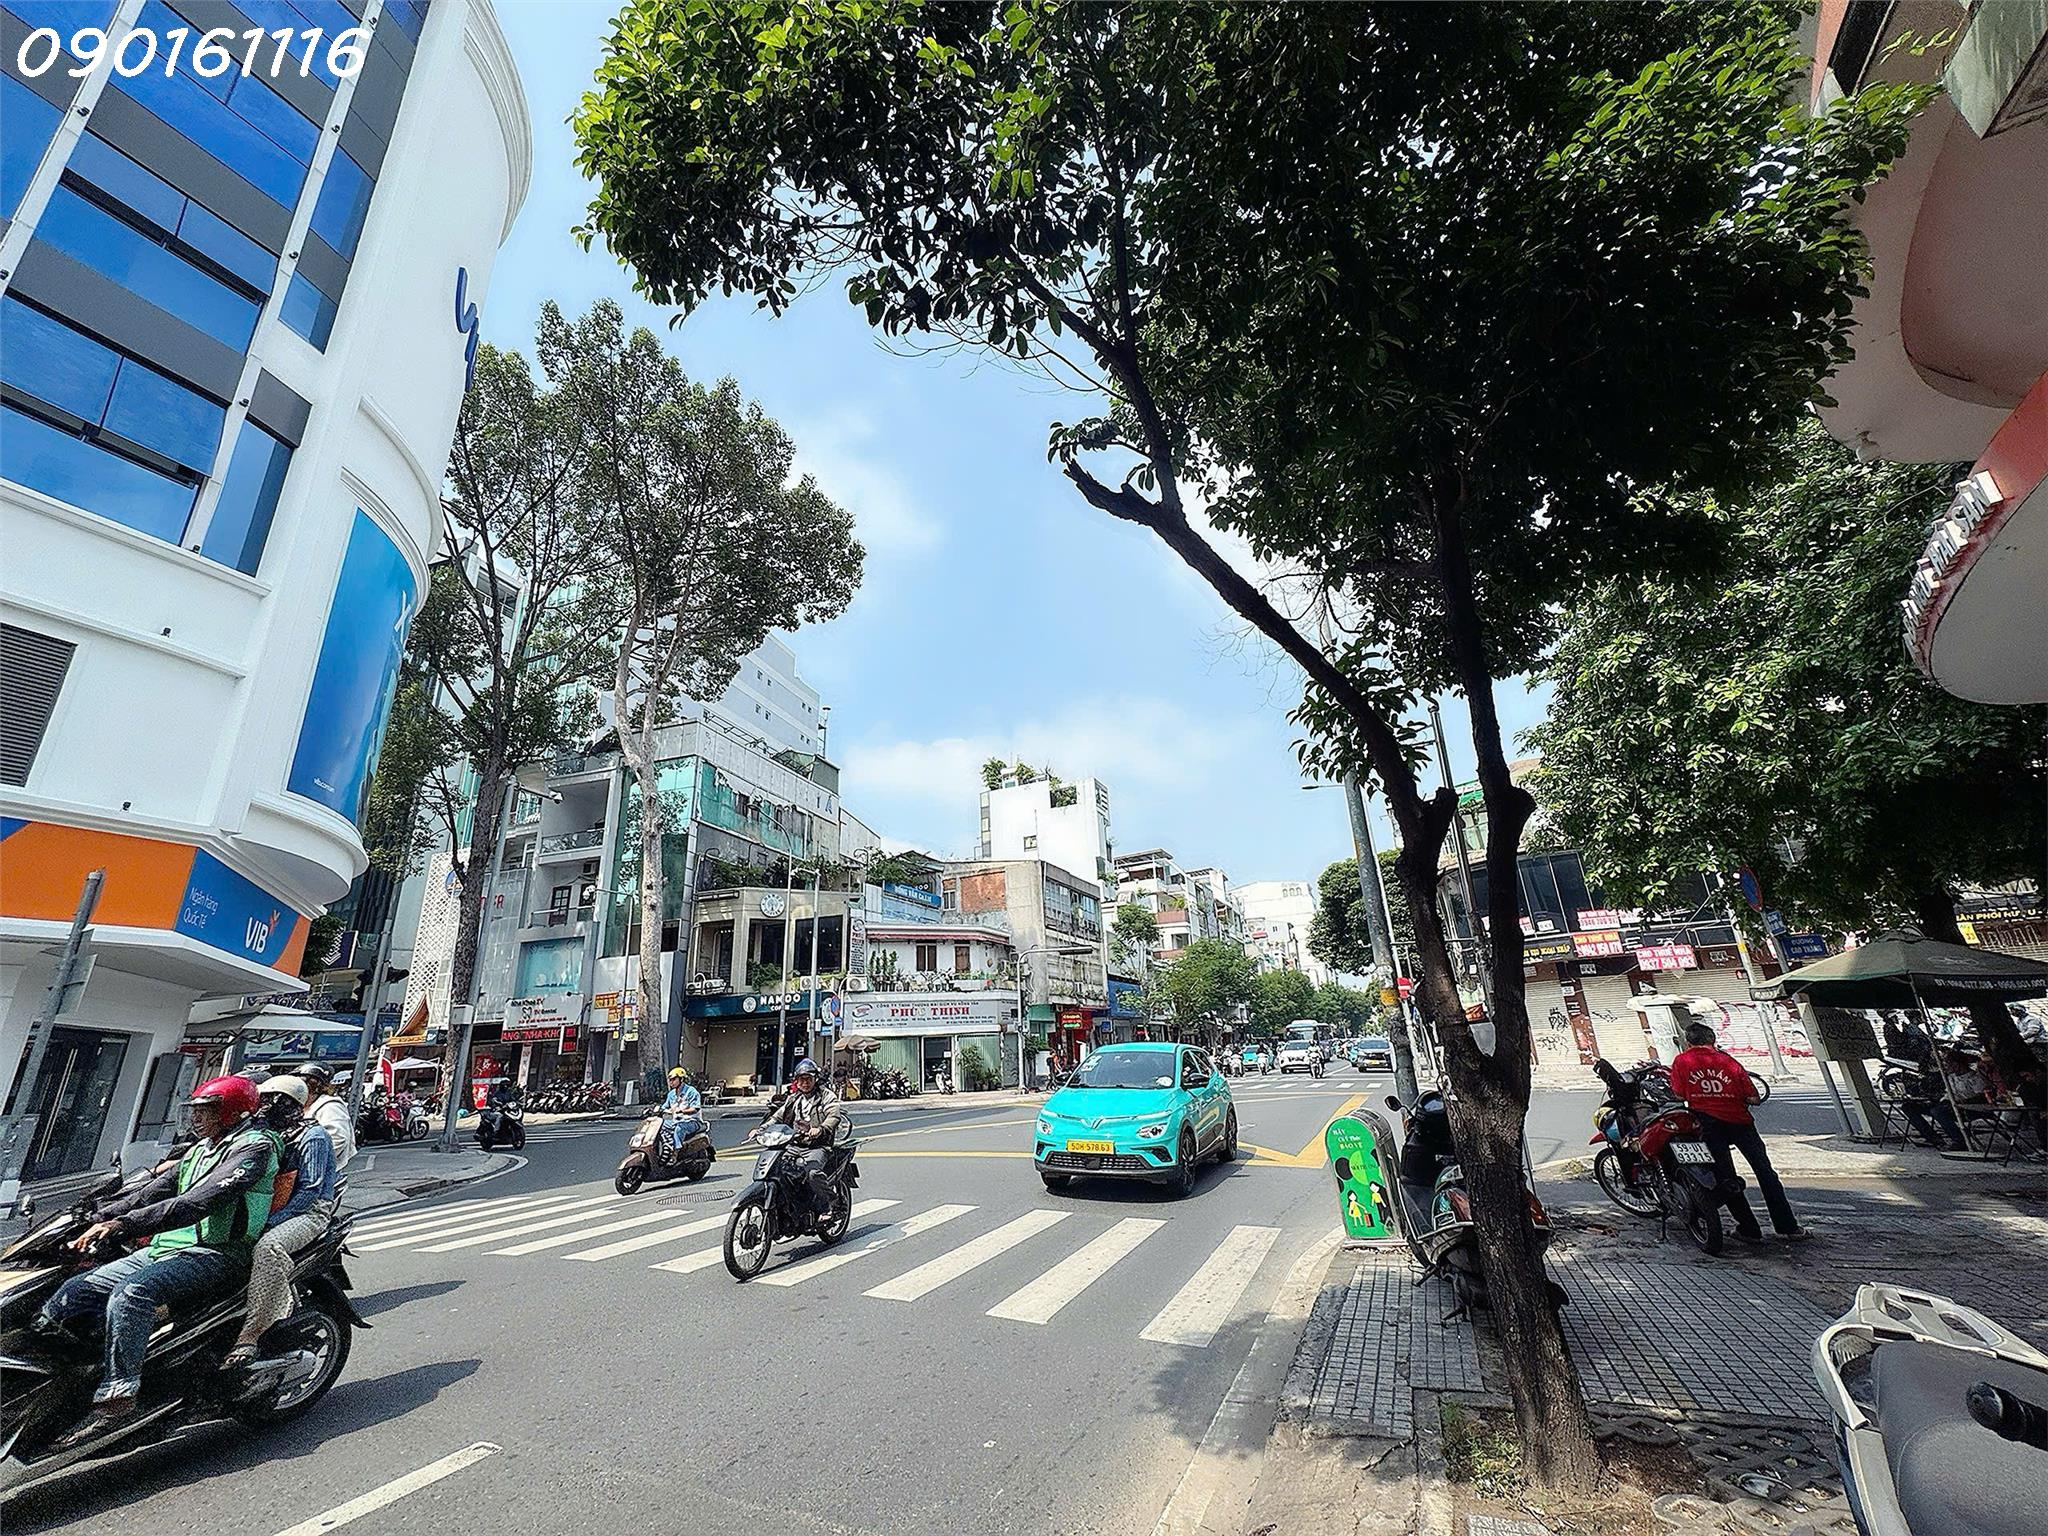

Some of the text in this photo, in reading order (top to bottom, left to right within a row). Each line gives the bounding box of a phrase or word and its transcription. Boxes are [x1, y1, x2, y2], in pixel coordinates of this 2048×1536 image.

[245, 916, 269, 954] VIB
[1689, 1068, 1732, 1085] LẨU MẮM
[1701, 1079, 1723, 1093] 9D
[1677, 1143, 1704, 1152] 59-U1
